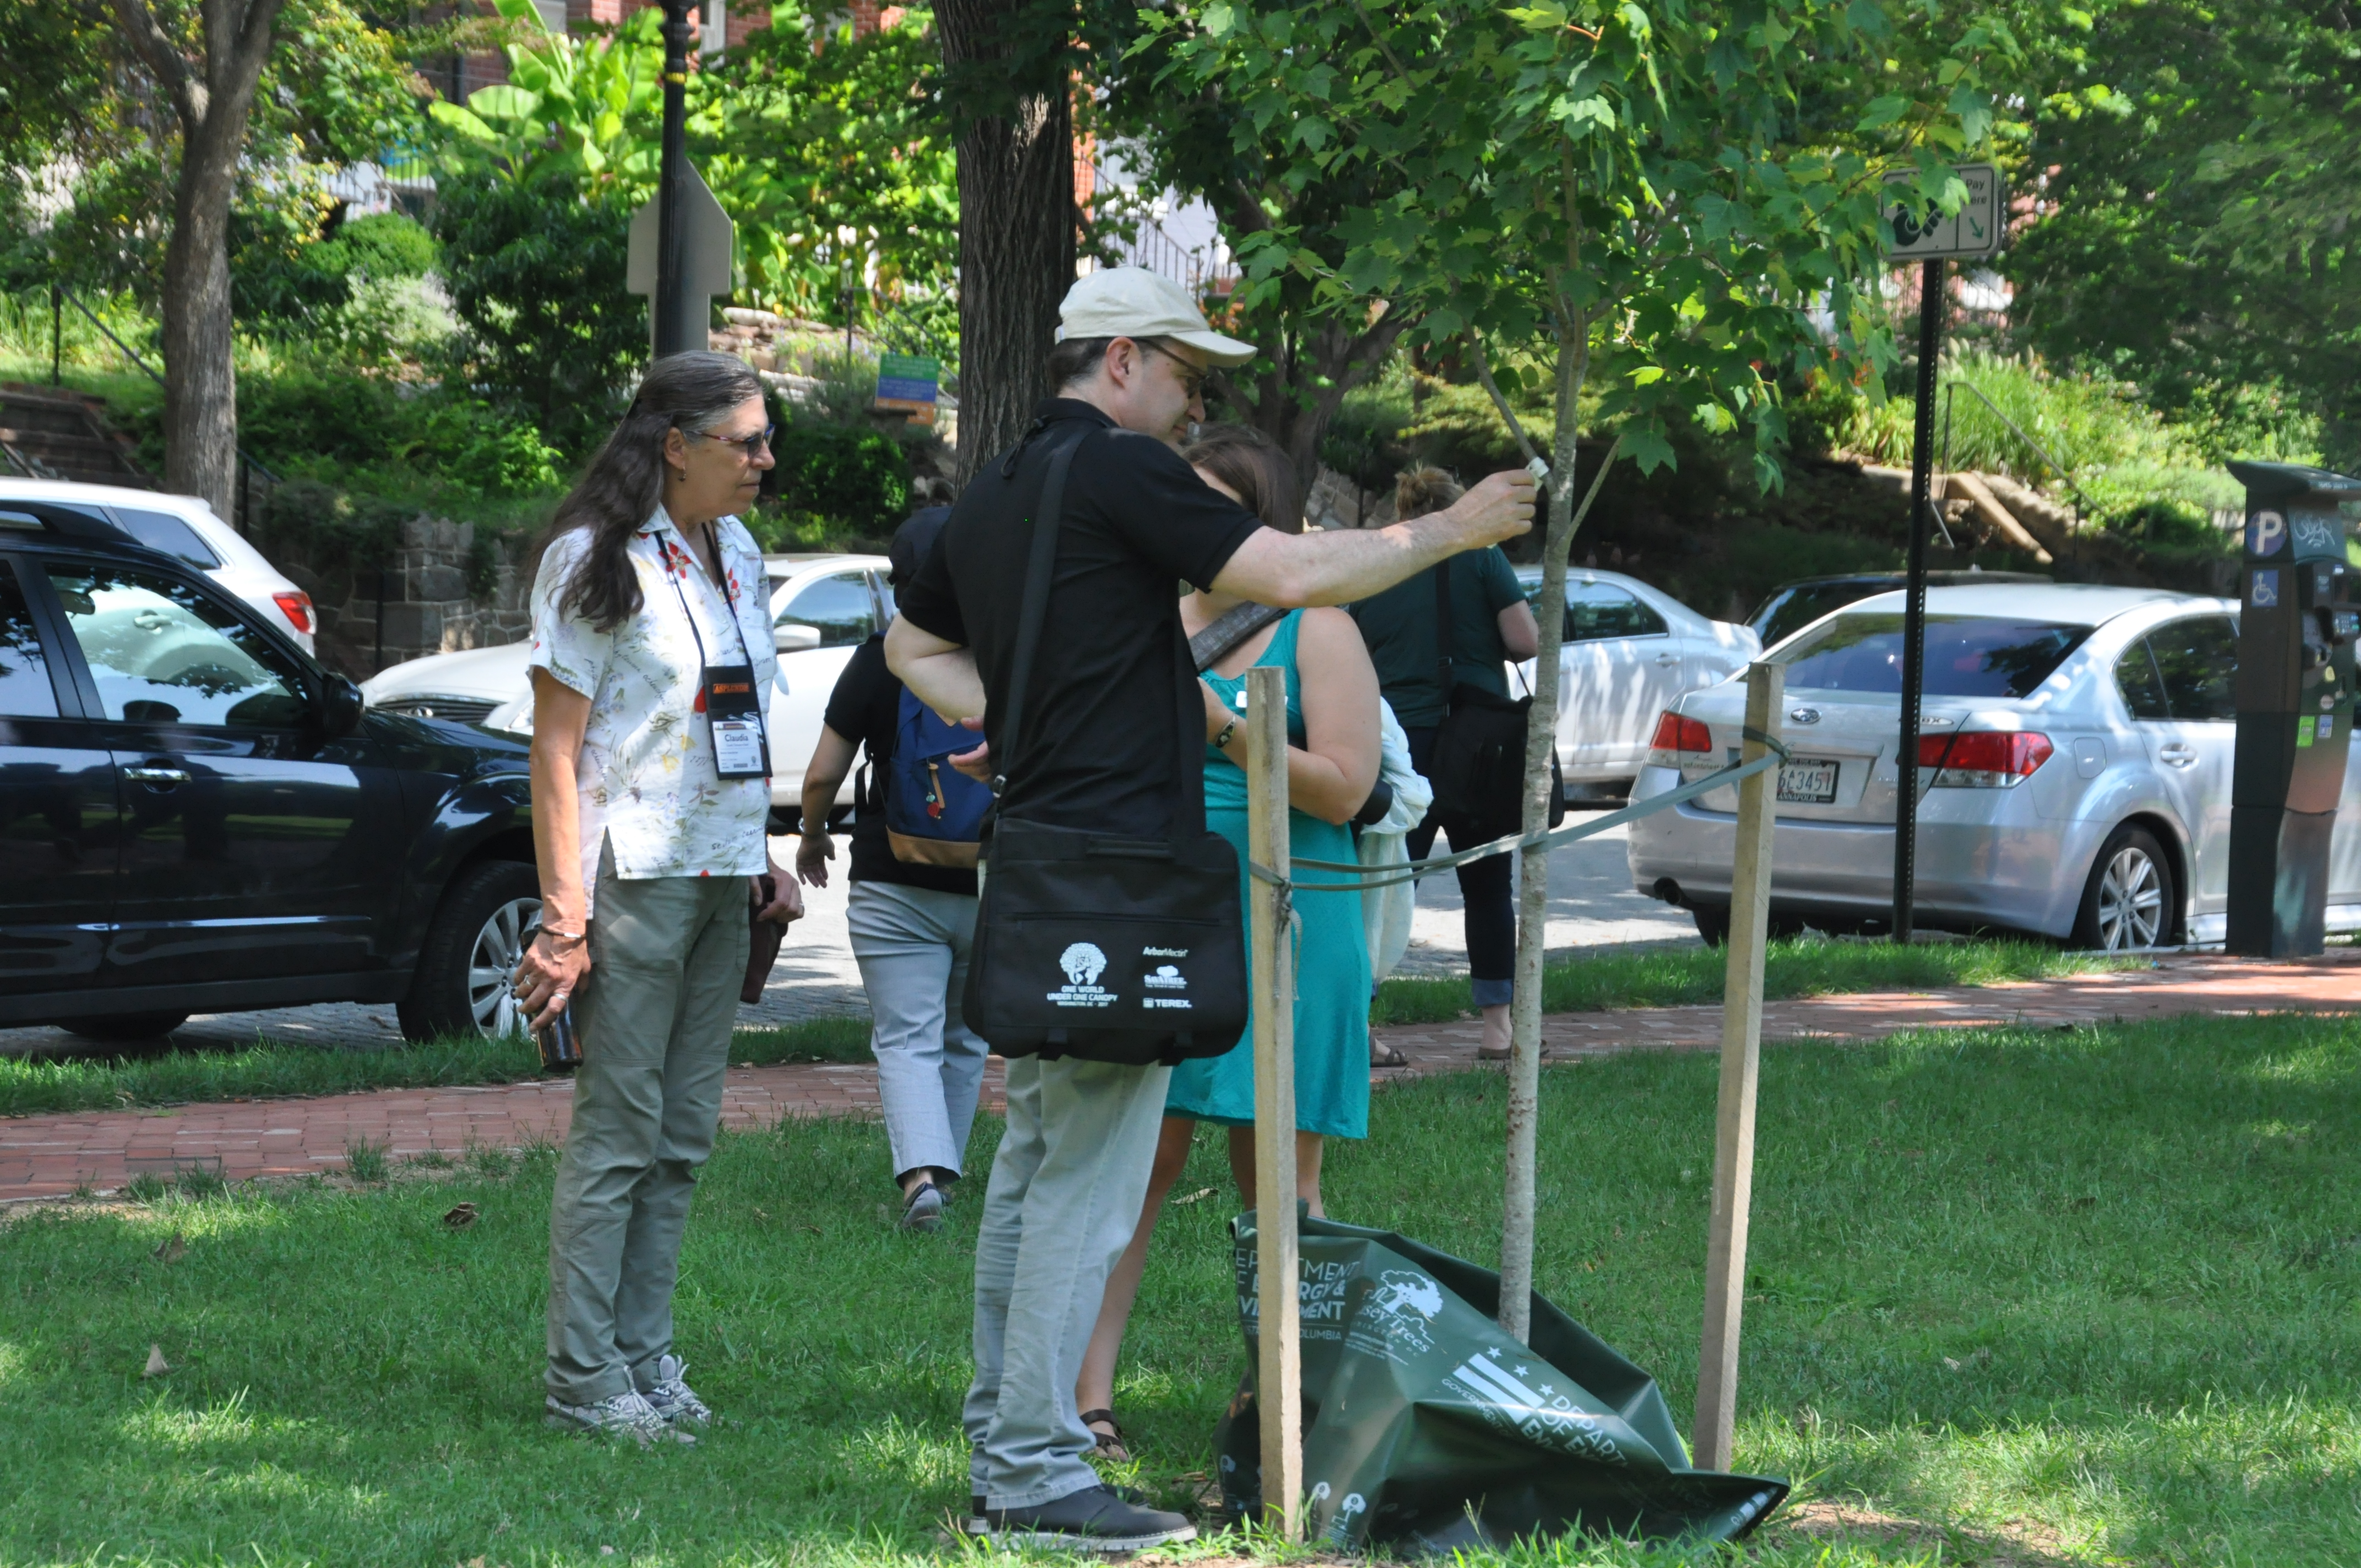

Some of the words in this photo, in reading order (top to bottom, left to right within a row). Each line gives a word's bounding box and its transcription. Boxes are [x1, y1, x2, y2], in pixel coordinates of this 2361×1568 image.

[1966, 178, 1985, 191] Pay
[2255, 511, 2282, 554] P
[725, 734, 749, 742] Claudia
[1078, 986, 1105, 994] WORLD
[1332, 1279, 1346, 1297] &
[1388, 1315, 1430, 1353] Trees
